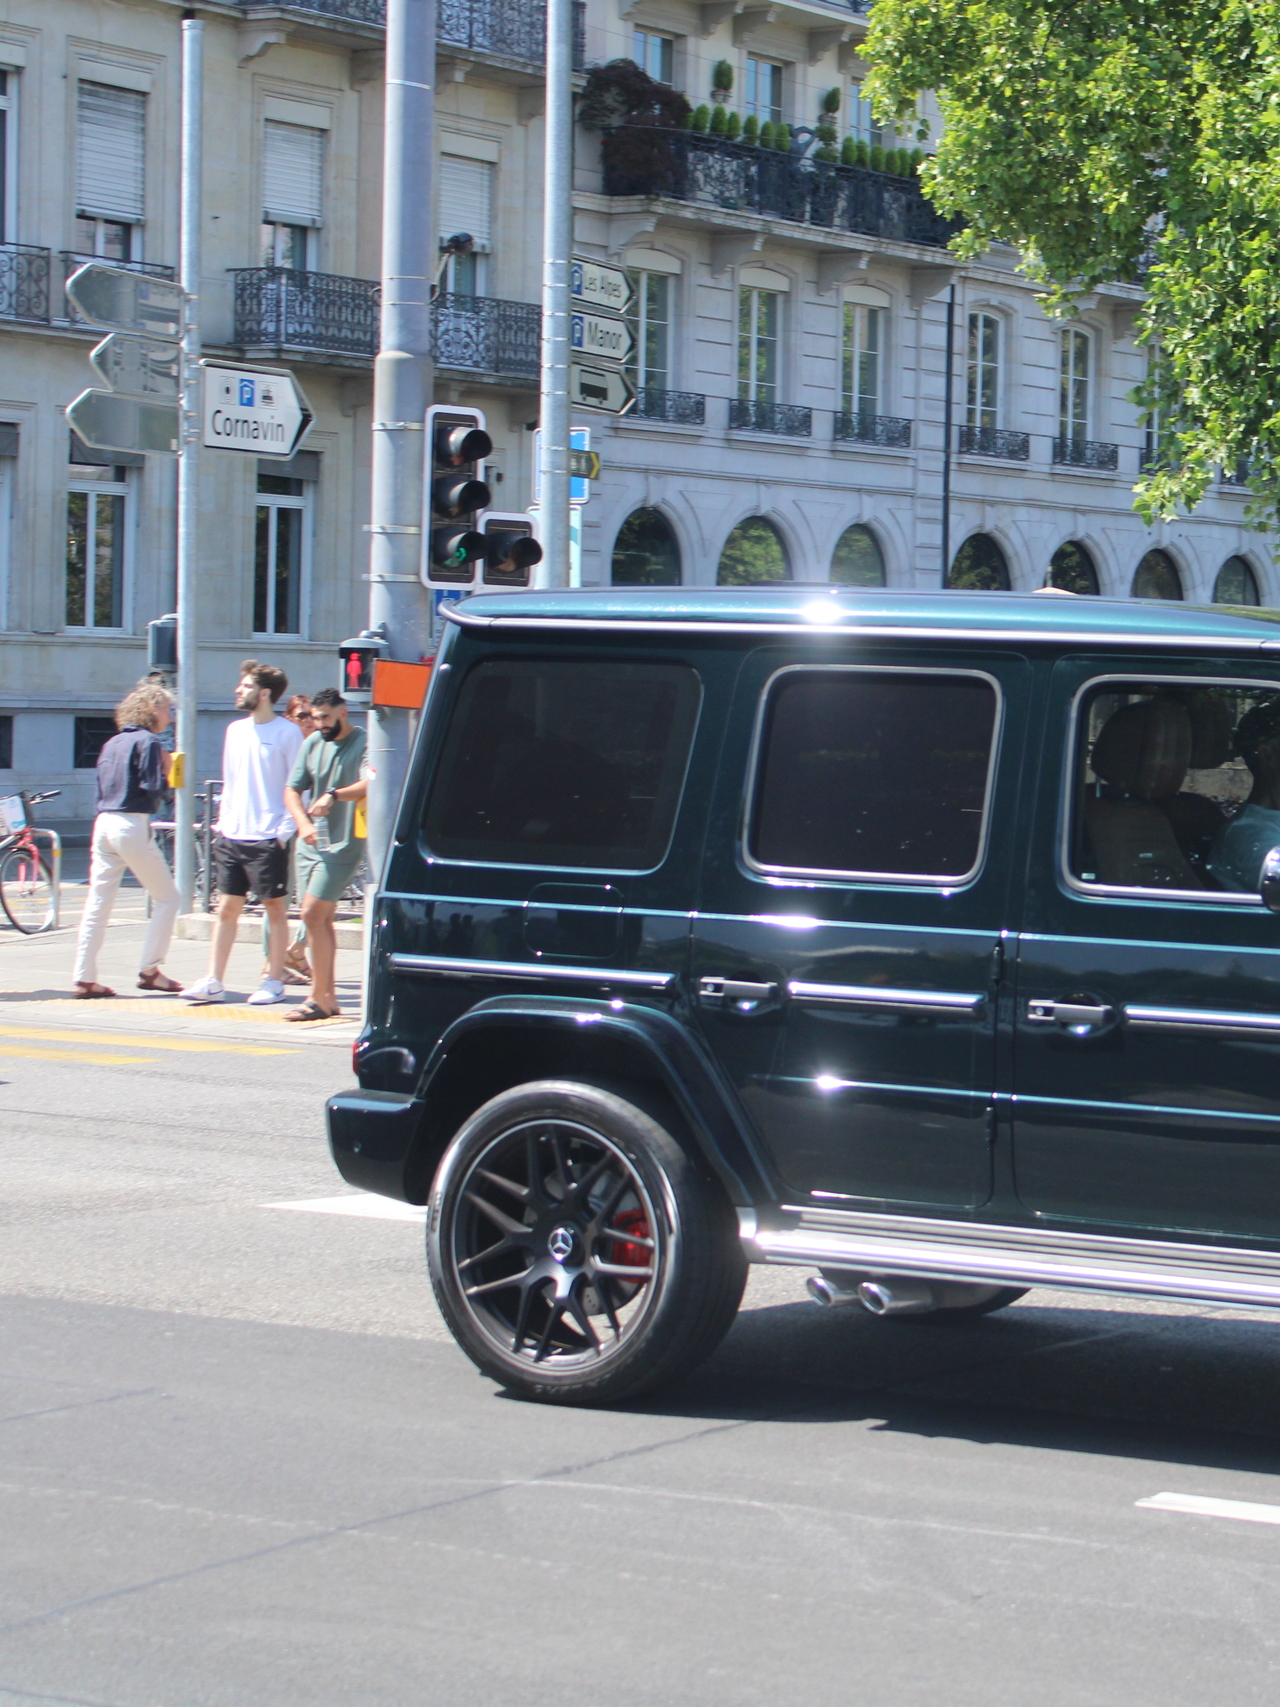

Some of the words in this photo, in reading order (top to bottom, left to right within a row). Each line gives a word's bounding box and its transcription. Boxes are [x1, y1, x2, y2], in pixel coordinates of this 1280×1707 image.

[585, 270, 597, 292] Les
[599, 274, 622, 301] Alpes
[587, 321, 622, 350] Manor
[212, 409, 285, 443] Cornavin
